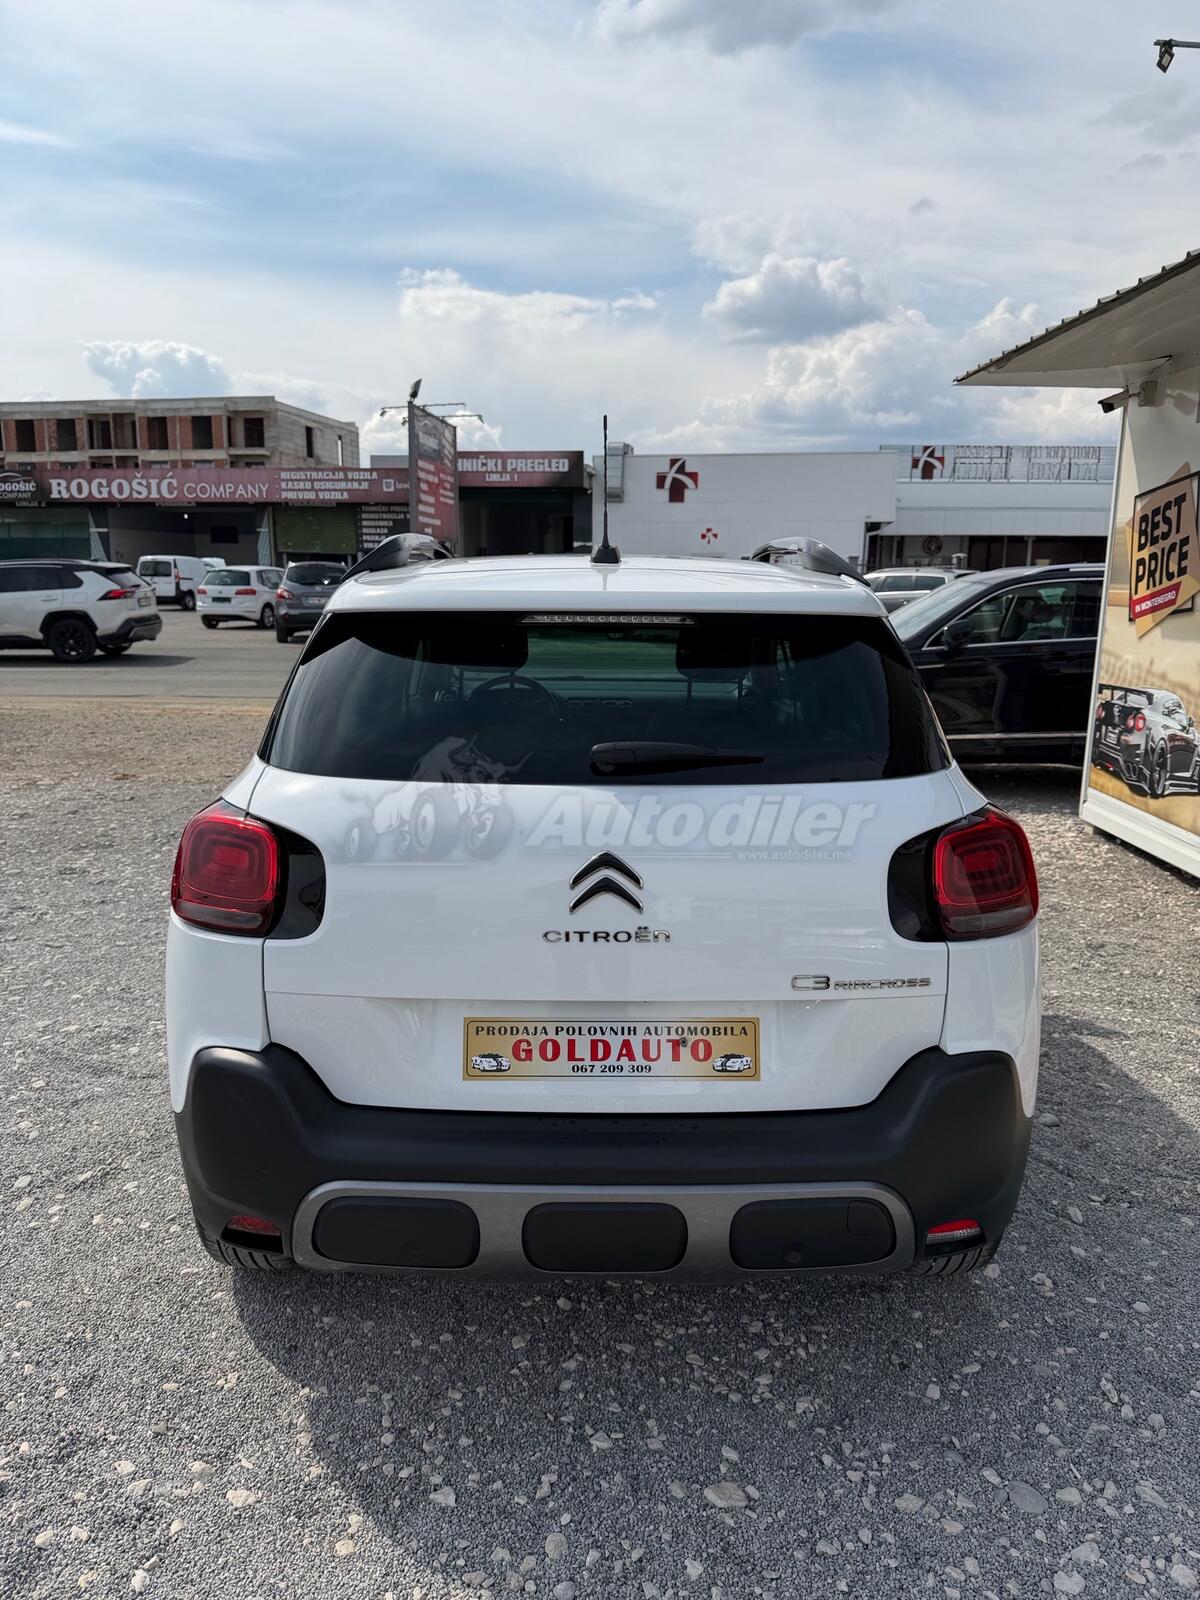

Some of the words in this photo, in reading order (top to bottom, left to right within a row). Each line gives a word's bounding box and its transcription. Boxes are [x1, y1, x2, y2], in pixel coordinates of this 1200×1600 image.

[506, 458, 569, 472] PREGLED
[280, 471, 345, 480] REGISTRACIJA
[347, 471, 378, 480] VOZILA
[485, 473, 511, 482] LINIJA
[0, 480, 37, 492] OGOŠIĆ
[49, 472, 178, 499] ROGOŠIĆ
[183, 482, 269, 499] COMPANY
[281, 481, 312, 490] KASKO
[313, 481, 370, 490] OSIGURANJE
[281, 491, 316, 500] PREVOD
[318, 491, 349, 500] VOZILA
[1137, 492, 1187, 553] BEST
[1134, 535, 1190, 596] PRICE
[1141, 590, 1177, 611] MONTENEGRO
[791, 974, 831, 991] C3
[834, 977, 932, 991] AIRCROSS
[475, 1025, 549, 1037] PRODAJA
[554, 1025, 638, 1037] POLOVNIH
[643, 1025, 749, 1037] AUTOMOBILA
[511, 1038, 714, 1063] GOLDAUTO
[571, 1064, 595, 1074] 067
[600, 1064, 624, 1074] 209
[628, 1064, 652, 1074] 309
